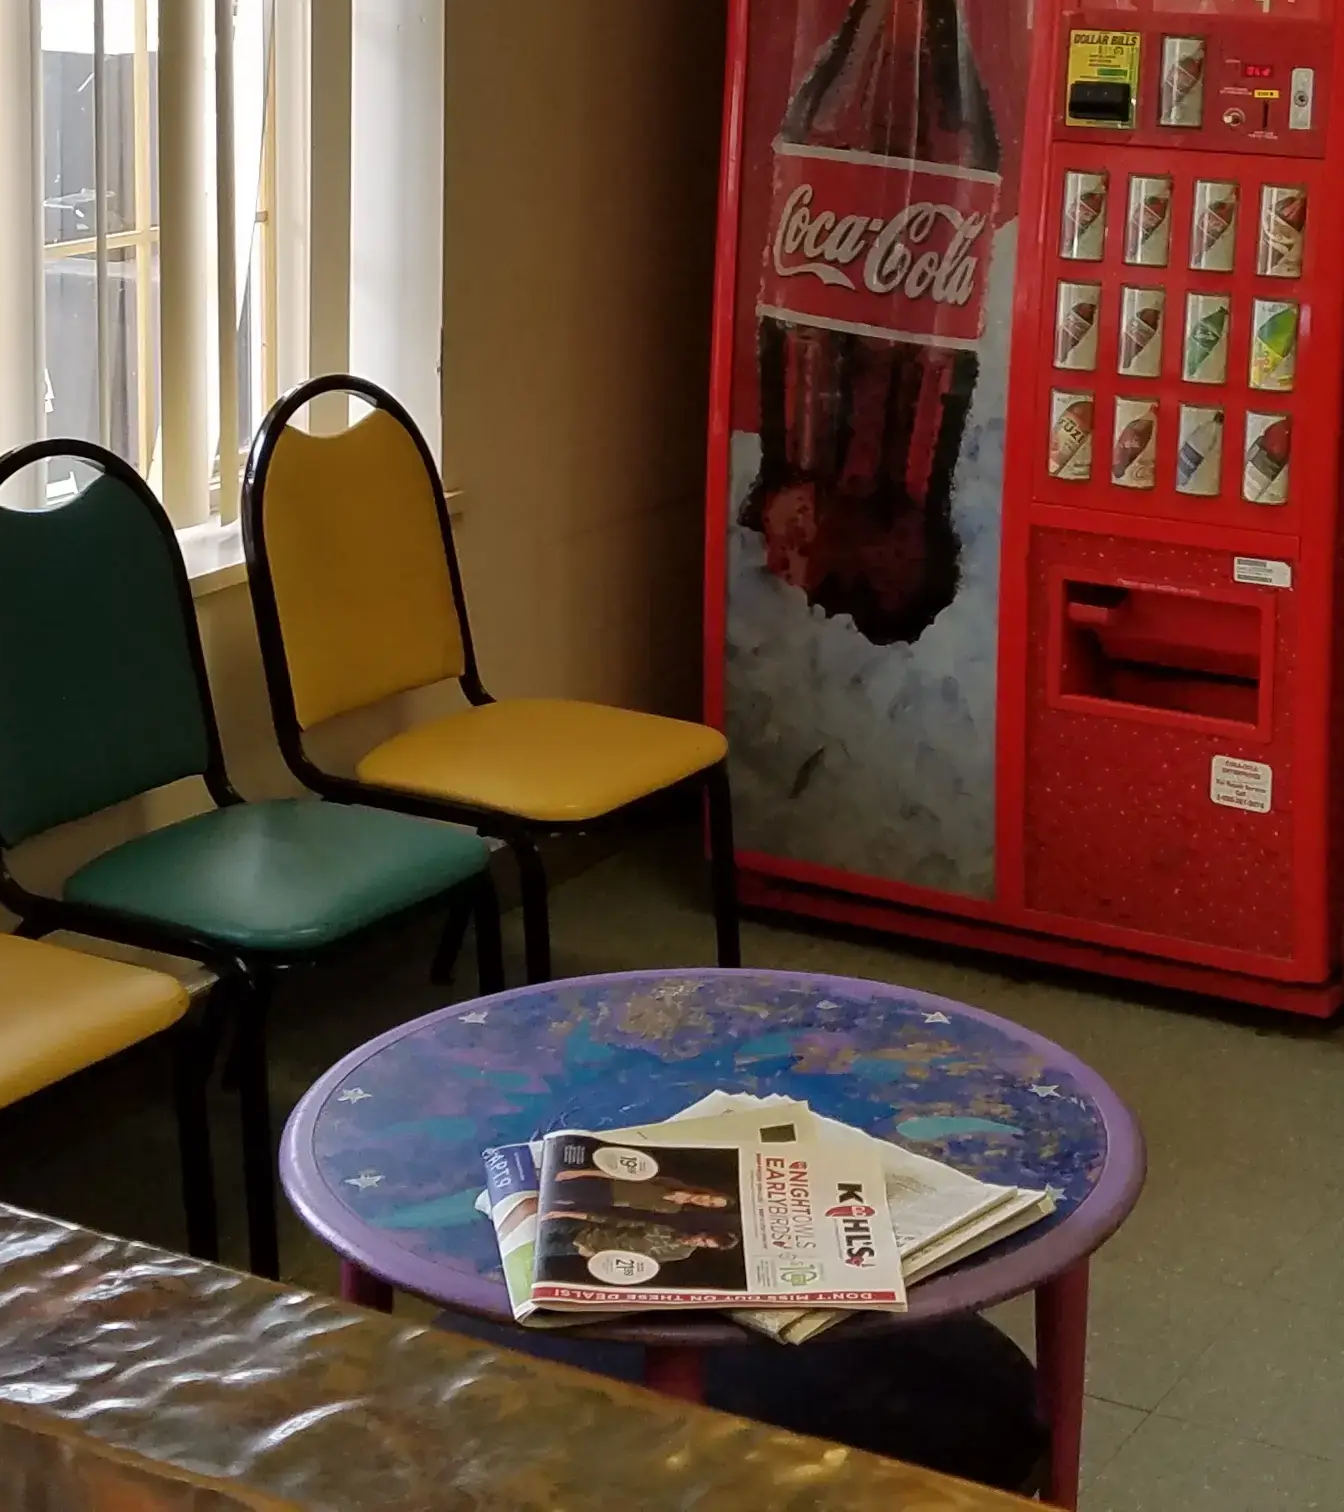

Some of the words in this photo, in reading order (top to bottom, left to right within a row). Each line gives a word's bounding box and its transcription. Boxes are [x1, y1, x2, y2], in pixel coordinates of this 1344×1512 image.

[1074, 34, 1110, 45] DOLLAR
[1111, 36, 1138, 46] BILLS
[773, 184, 987, 306] Coca-Cola
[817, 1292, 873, 1300] DON'T
